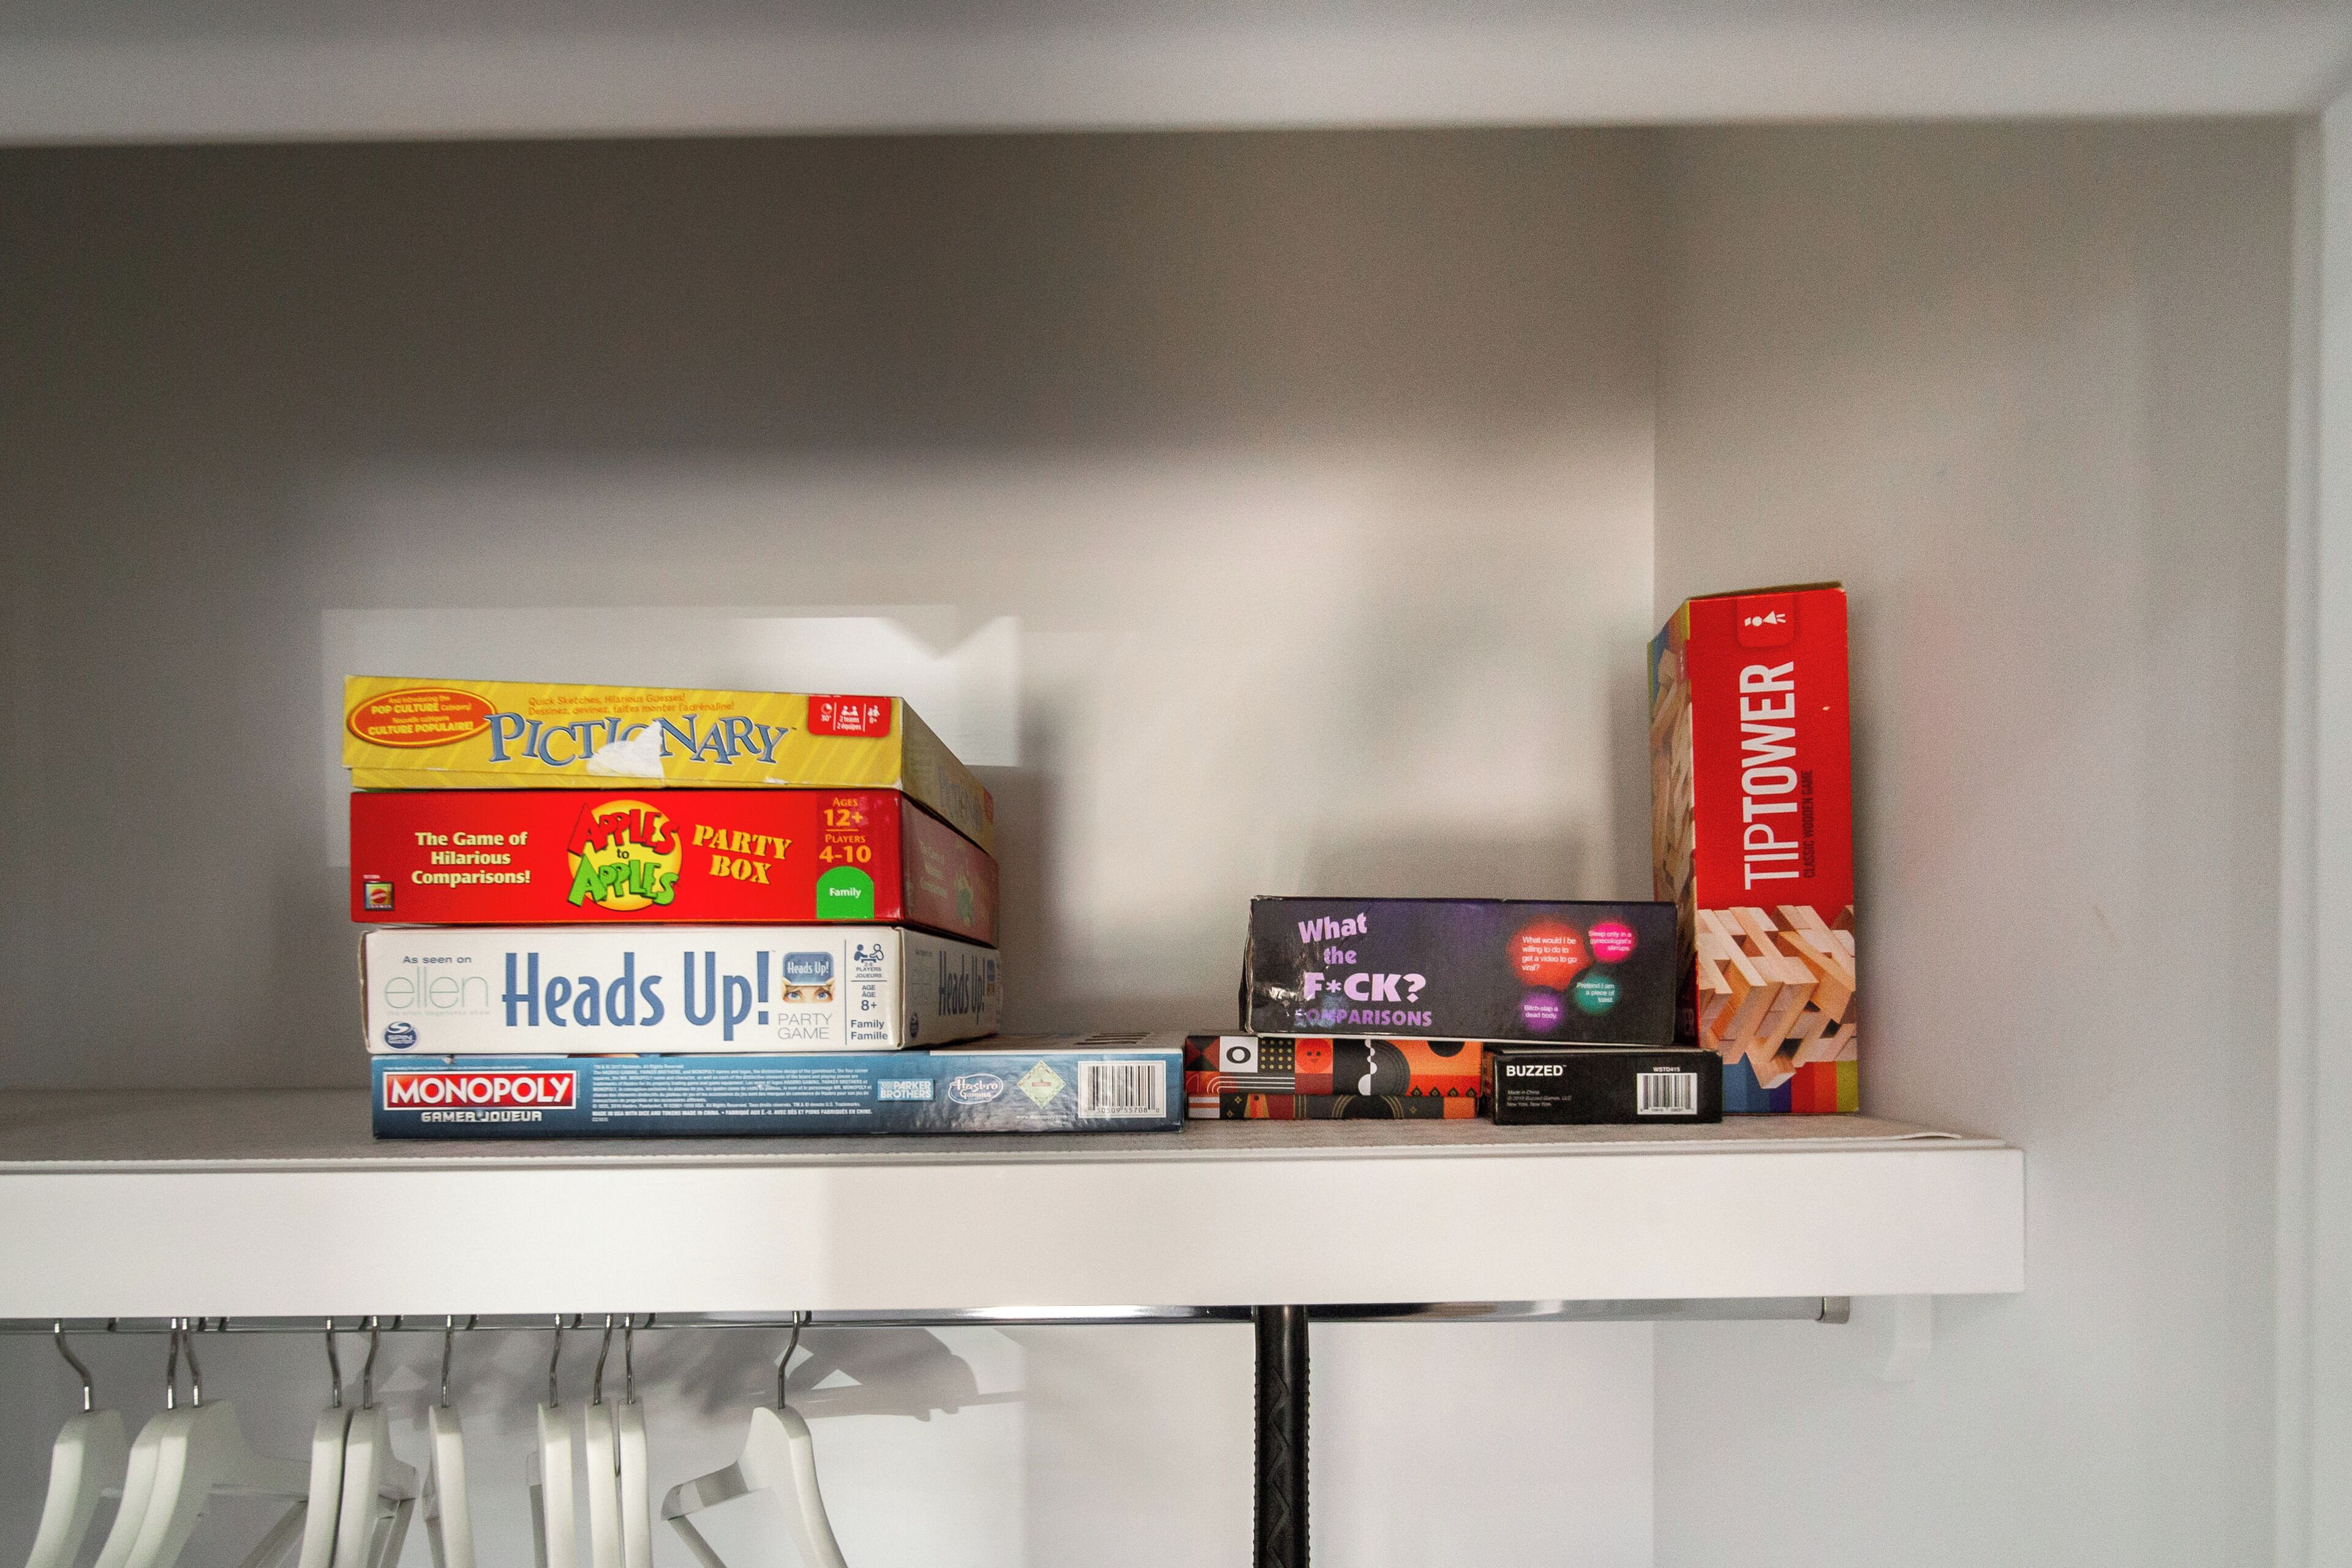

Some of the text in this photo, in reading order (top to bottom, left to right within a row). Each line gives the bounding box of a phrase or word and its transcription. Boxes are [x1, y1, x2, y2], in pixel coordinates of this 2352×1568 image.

[529, 697, 554, 706] Quick
[605, 695, 643, 703] Hilarious
[647, 693, 685, 702] Guesses!
[371, 706, 392, 714] POP
[393, 703, 440, 714] CULTURE
[368, 722, 473, 734] CULTURE POPULAIRE!
[1740, 661, 1799, 891] TIPTOWER
[824, 809, 864, 826] 12+
[1801, 770, 1815, 878] CLASSIC WOODEN GAME
[567, 802, 680, 856] APPLES
[415, 831, 528, 846] The Game of
[692, 824, 793, 860] PARTY
[825, 834, 865, 843] PLAYERS
[431, 850, 511, 865] Hilarious
[617, 848, 629, 859] to
[819, 845, 872, 863] 4-10
[709, 854, 772, 884] BOX
[412, 870, 531, 888] Comparisons!
[567, 853, 679, 907] APPLES
[829, 888, 861, 899] Family
[1297, 912, 1367, 944] What
[1324, 946, 1357, 964] the
[787, 961, 829, 976] Heads Up!
[385, 966, 488, 1009] ellen
[938, 951, 969, 1016] Heads
[502, 951, 769, 1041] Heads Up!
[861, 1000, 877, 1011] 8+
[778, 1014, 832, 1025] PARTY
[851, 1020, 884, 1030] Family
[778, 1027, 829, 1039] GAME
[851, 1031, 888, 1040] Famille
[1506, 1065, 1563, 1076] BUZZED
[391, 1077, 571, 1104] MONOPOLY
[894, 1080, 931, 1090] PARKER
[951, 1079, 998, 1092] Hasbro
[881, 1090, 931, 1099] BROTHERS
[960, 1090, 990, 1099] Gaming
[421, 1110, 542, 1122] GAMER JOUEUR
